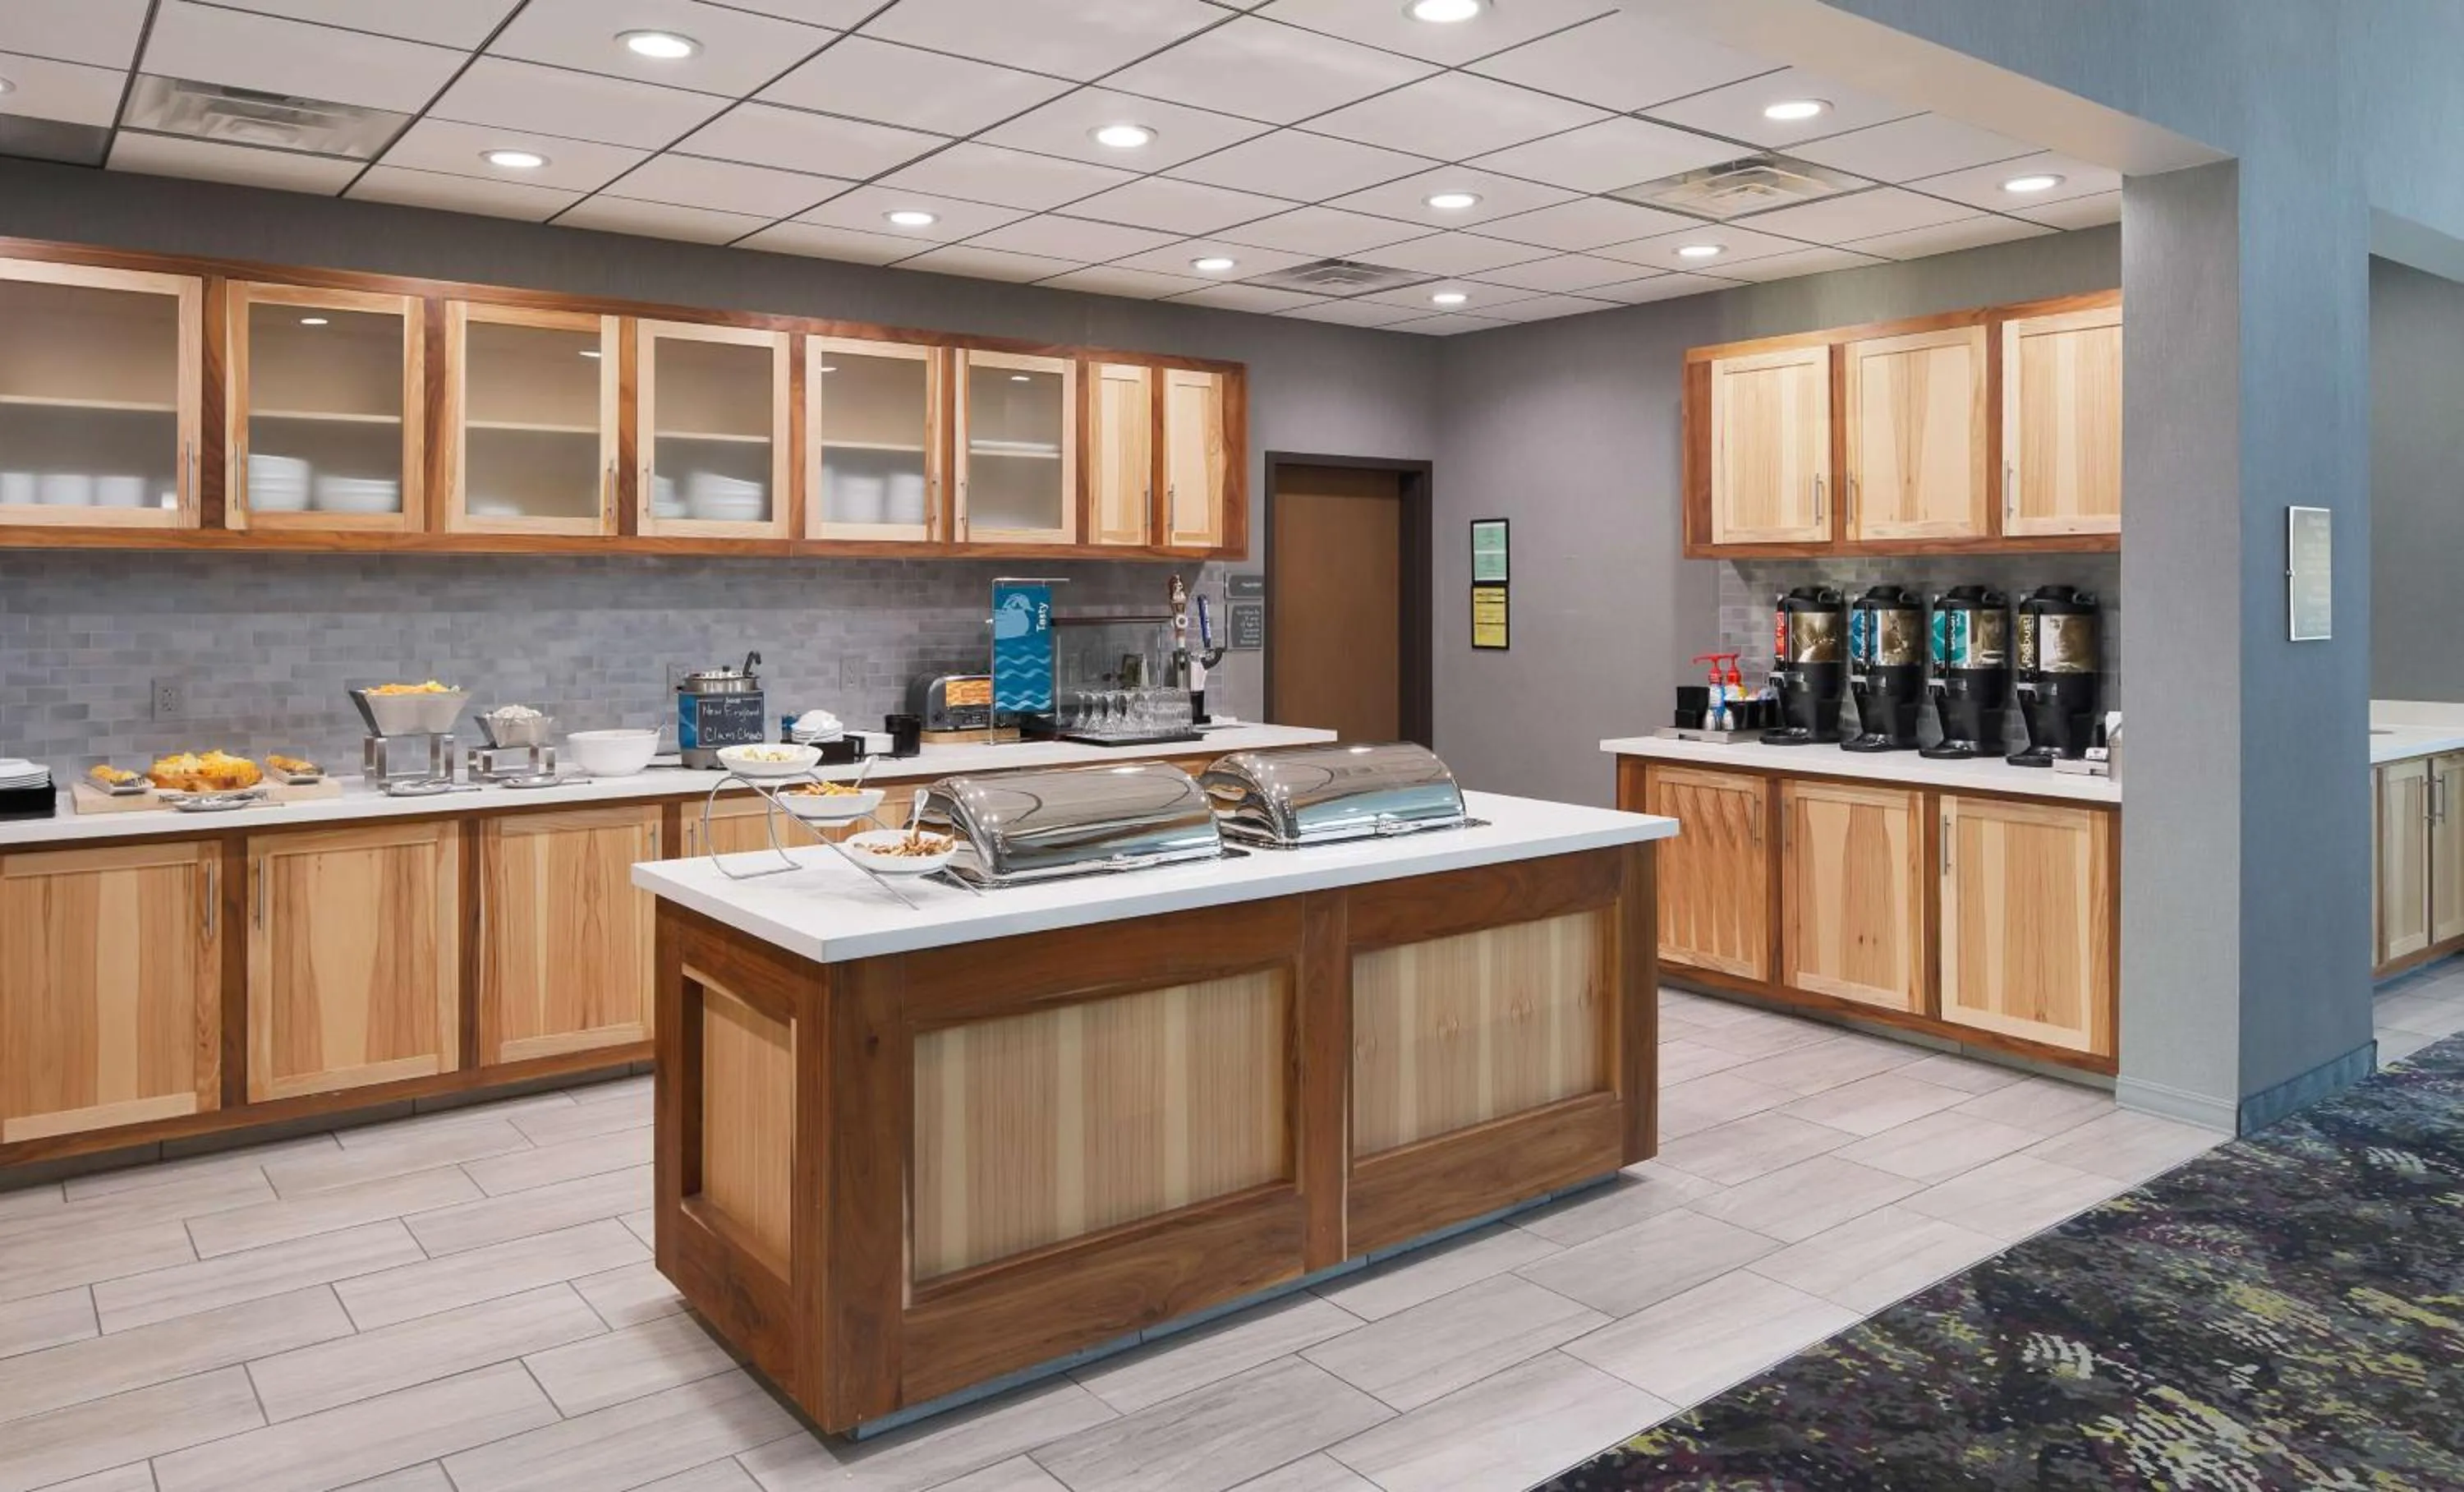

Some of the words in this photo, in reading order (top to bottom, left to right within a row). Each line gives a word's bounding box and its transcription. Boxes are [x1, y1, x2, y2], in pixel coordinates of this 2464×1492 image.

[1036, 601, 1049, 633] Tasty
[702, 703, 723, 716] New
[705, 727, 735, 742] Clam
